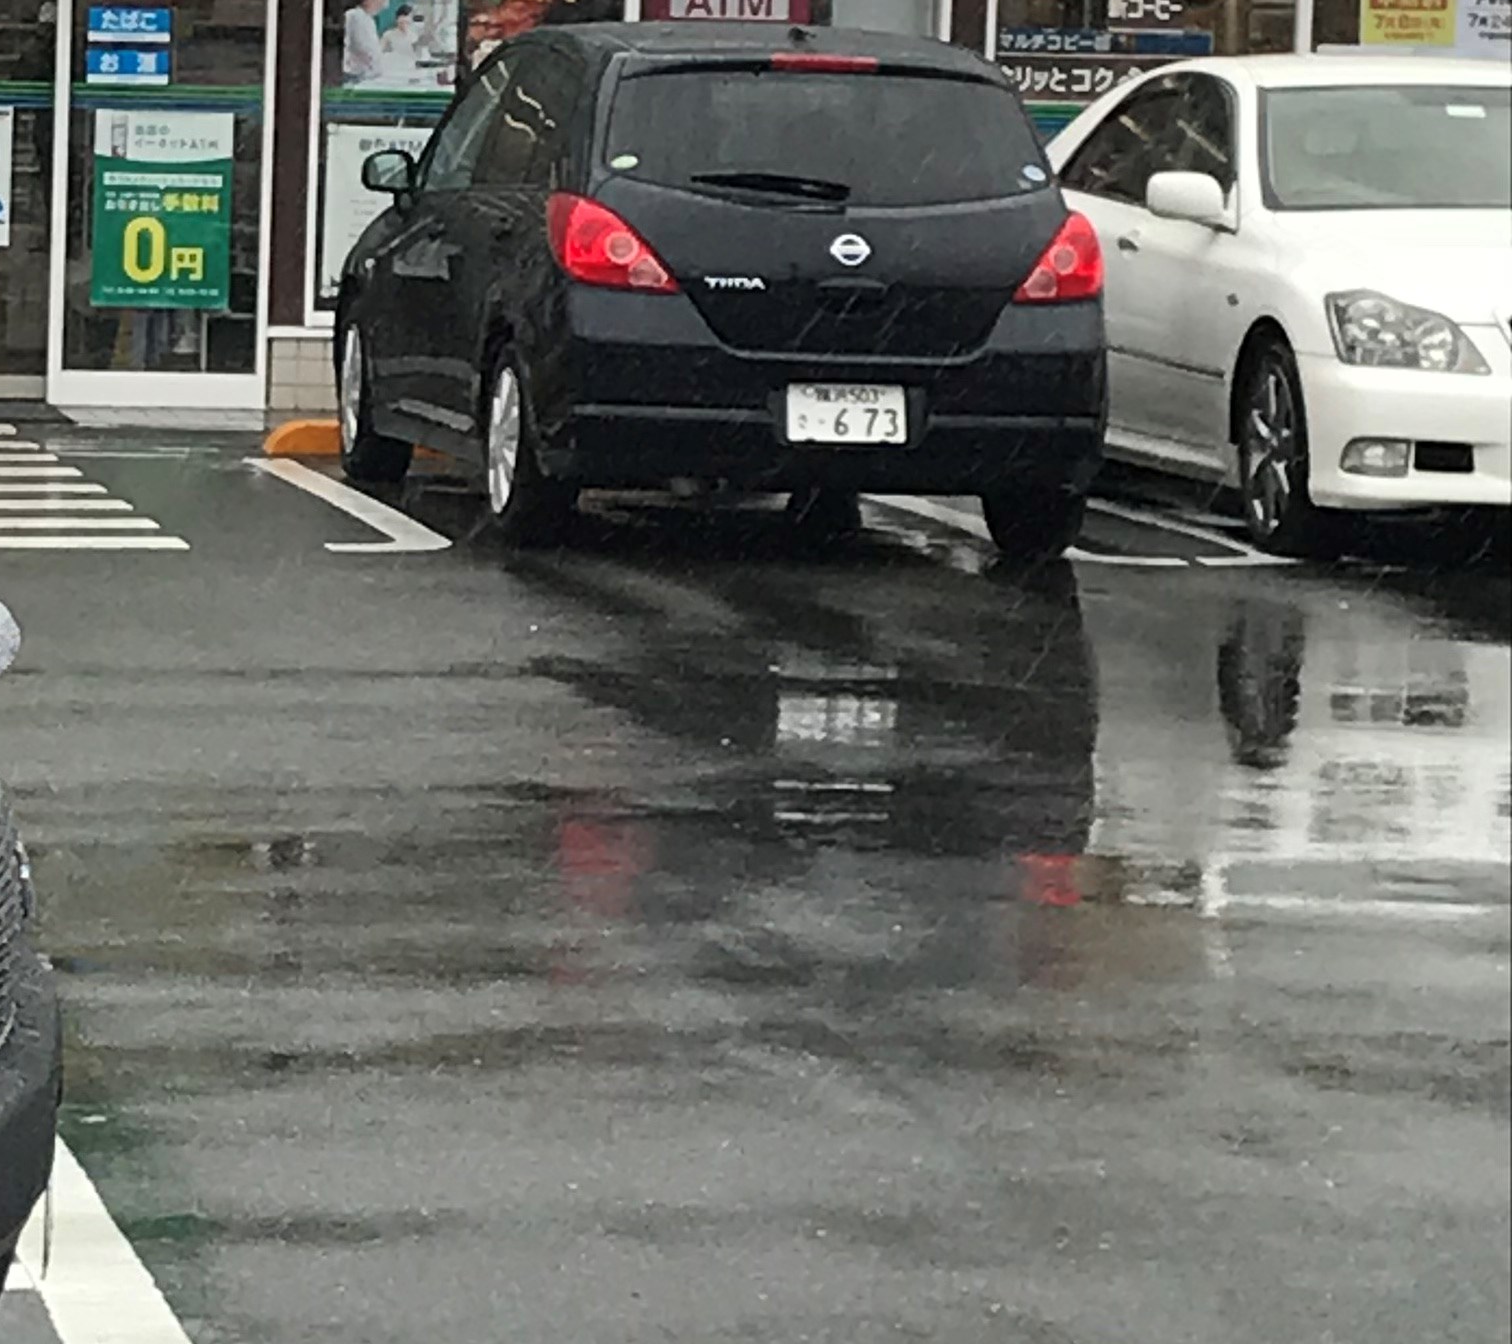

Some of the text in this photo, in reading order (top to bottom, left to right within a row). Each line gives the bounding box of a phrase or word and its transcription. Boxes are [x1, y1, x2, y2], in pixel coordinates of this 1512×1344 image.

[100, 9, 158, 31] たばこ
[123, 216, 203, 283] 0円
